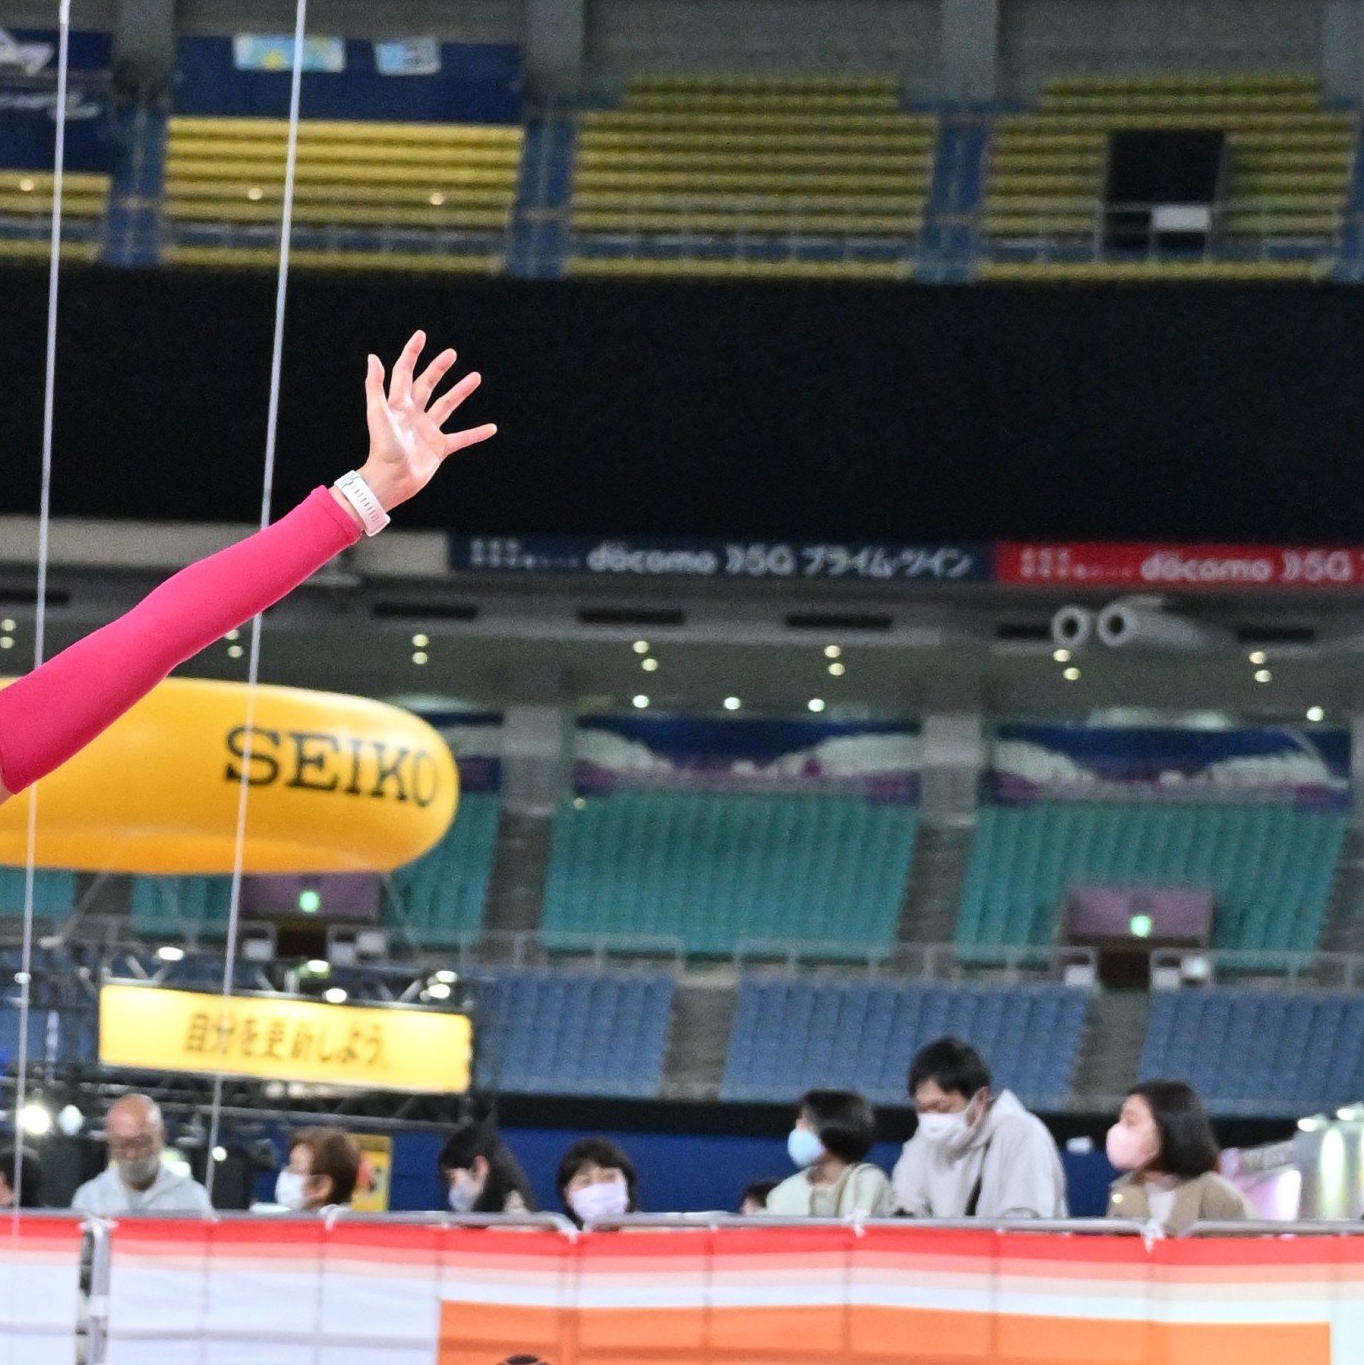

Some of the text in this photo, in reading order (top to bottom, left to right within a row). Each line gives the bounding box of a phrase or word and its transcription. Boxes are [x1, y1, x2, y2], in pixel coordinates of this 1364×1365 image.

[587, 541, 717, 576] docomo
[1140, 550, 1273, 582] docomo
[224, 726, 439, 808] SEIKO
